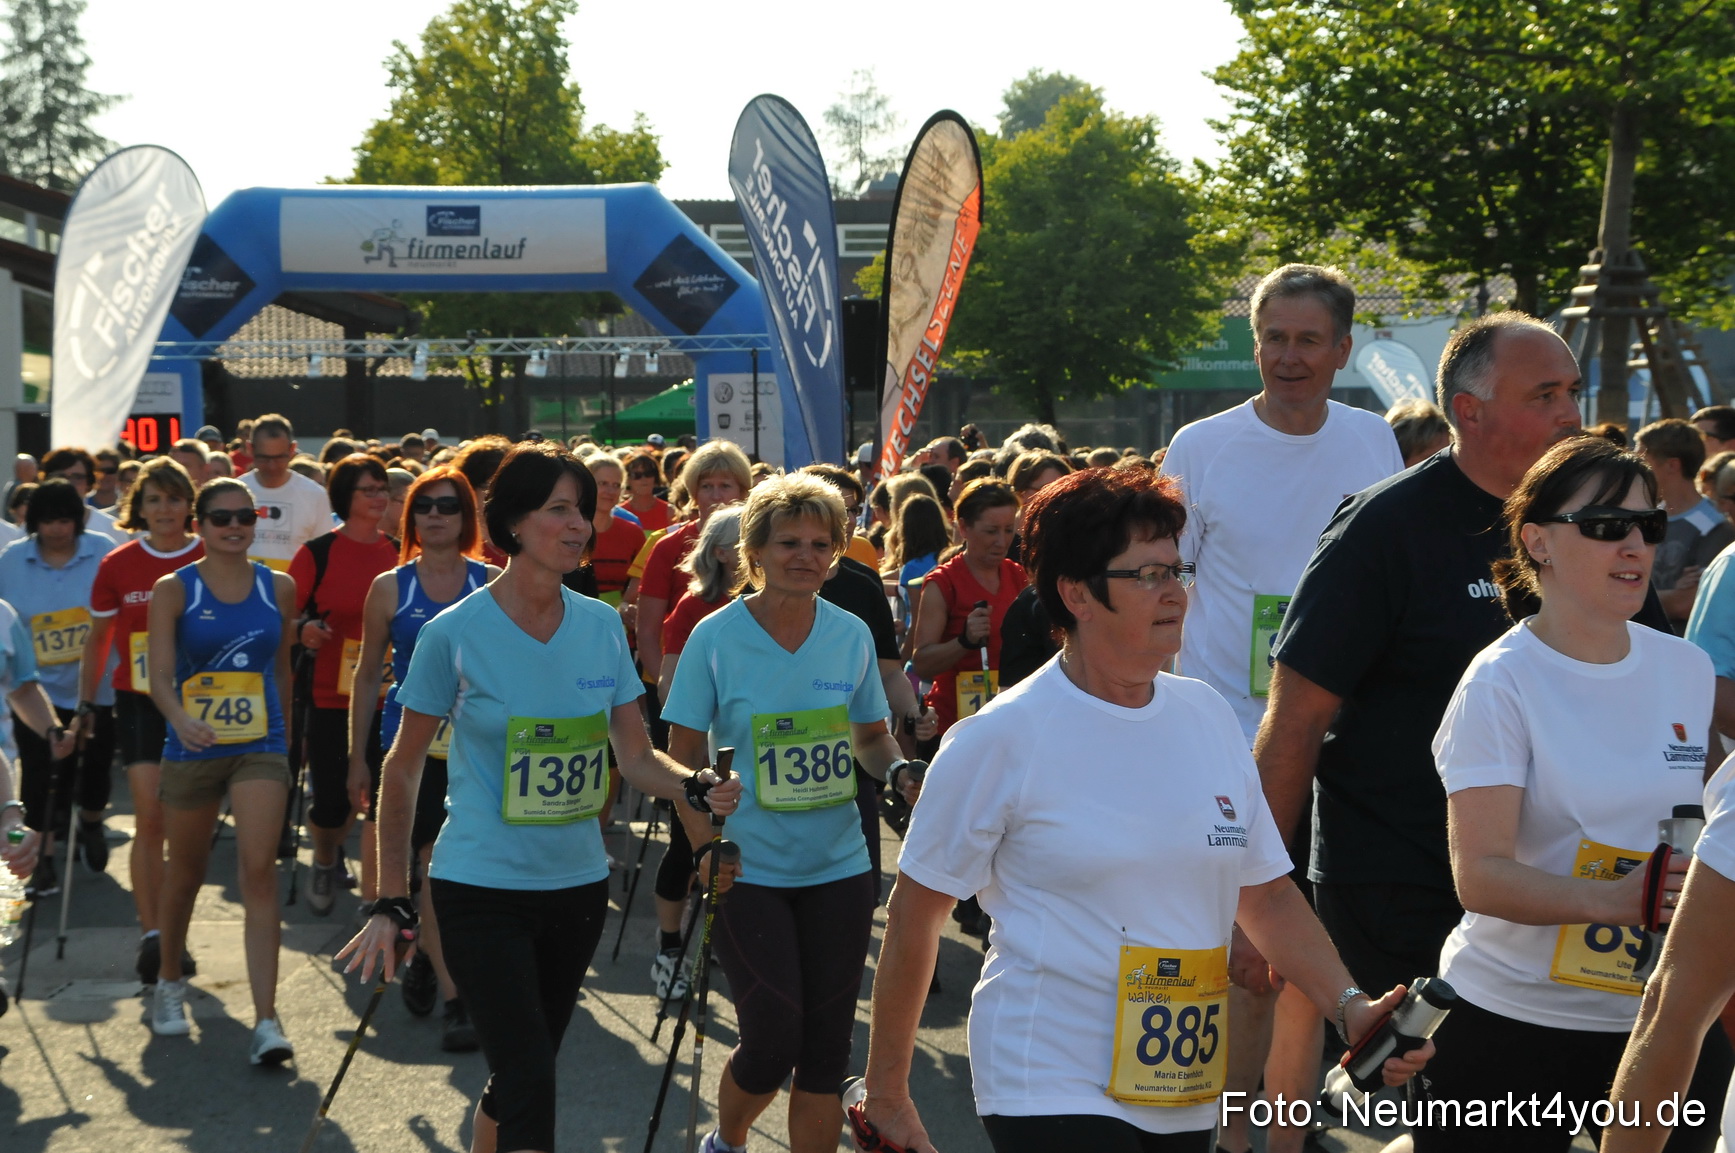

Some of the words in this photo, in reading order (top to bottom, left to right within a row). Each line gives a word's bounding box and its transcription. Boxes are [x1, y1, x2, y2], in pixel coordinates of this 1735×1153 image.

[407, 236, 527, 260] firmenlauf
[92, 181, 173, 350] Fischer
[181, 277, 241, 291] ischer
[37, 624, 90, 653] 1372
[587, 676, 615, 689] sumida
[823, 680, 854, 692] sumida
[195, 697, 253, 726] 748
[758, 740, 852, 786] 1386
[510, 749, 603, 797] 1381
[1145, 974, 1197, 987] firmenlauf
[1580, 966, 1629, 981] Neumarkter
[1127, 990, 1171, 1005] walken
[1136, 1004, 1220, 1068] 885
[1154, 1070, 1177, 1080] Maria
[1134, 1083, 1177, 1093] Neumarkter
